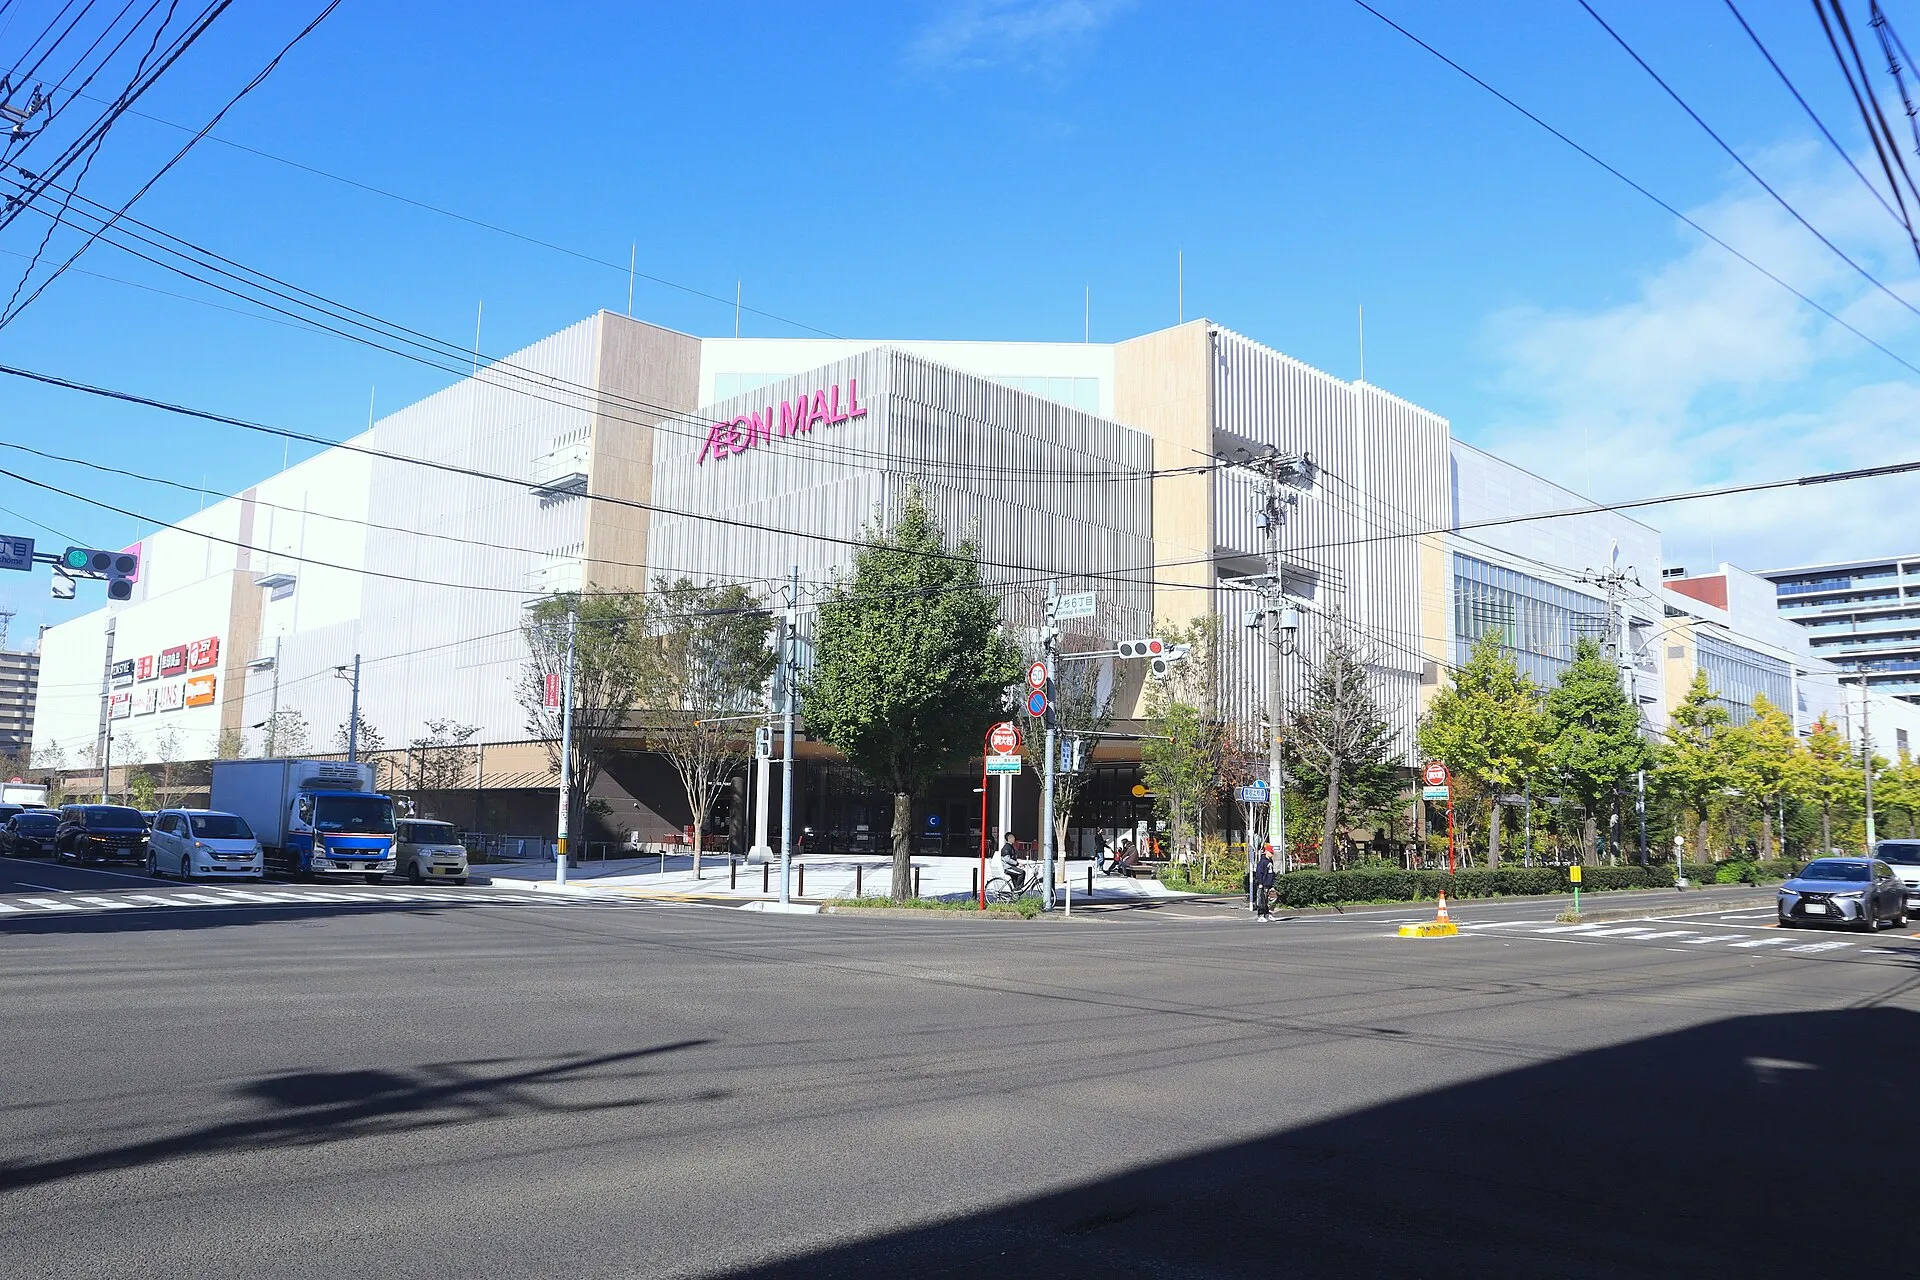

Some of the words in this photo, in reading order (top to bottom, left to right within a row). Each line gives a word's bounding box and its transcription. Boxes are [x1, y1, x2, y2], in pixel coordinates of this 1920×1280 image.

[780, 378, 867, 438] MALL
[1032, 669, 1043, 681] 50
[993, 735, 1014, 746] 消火栓
